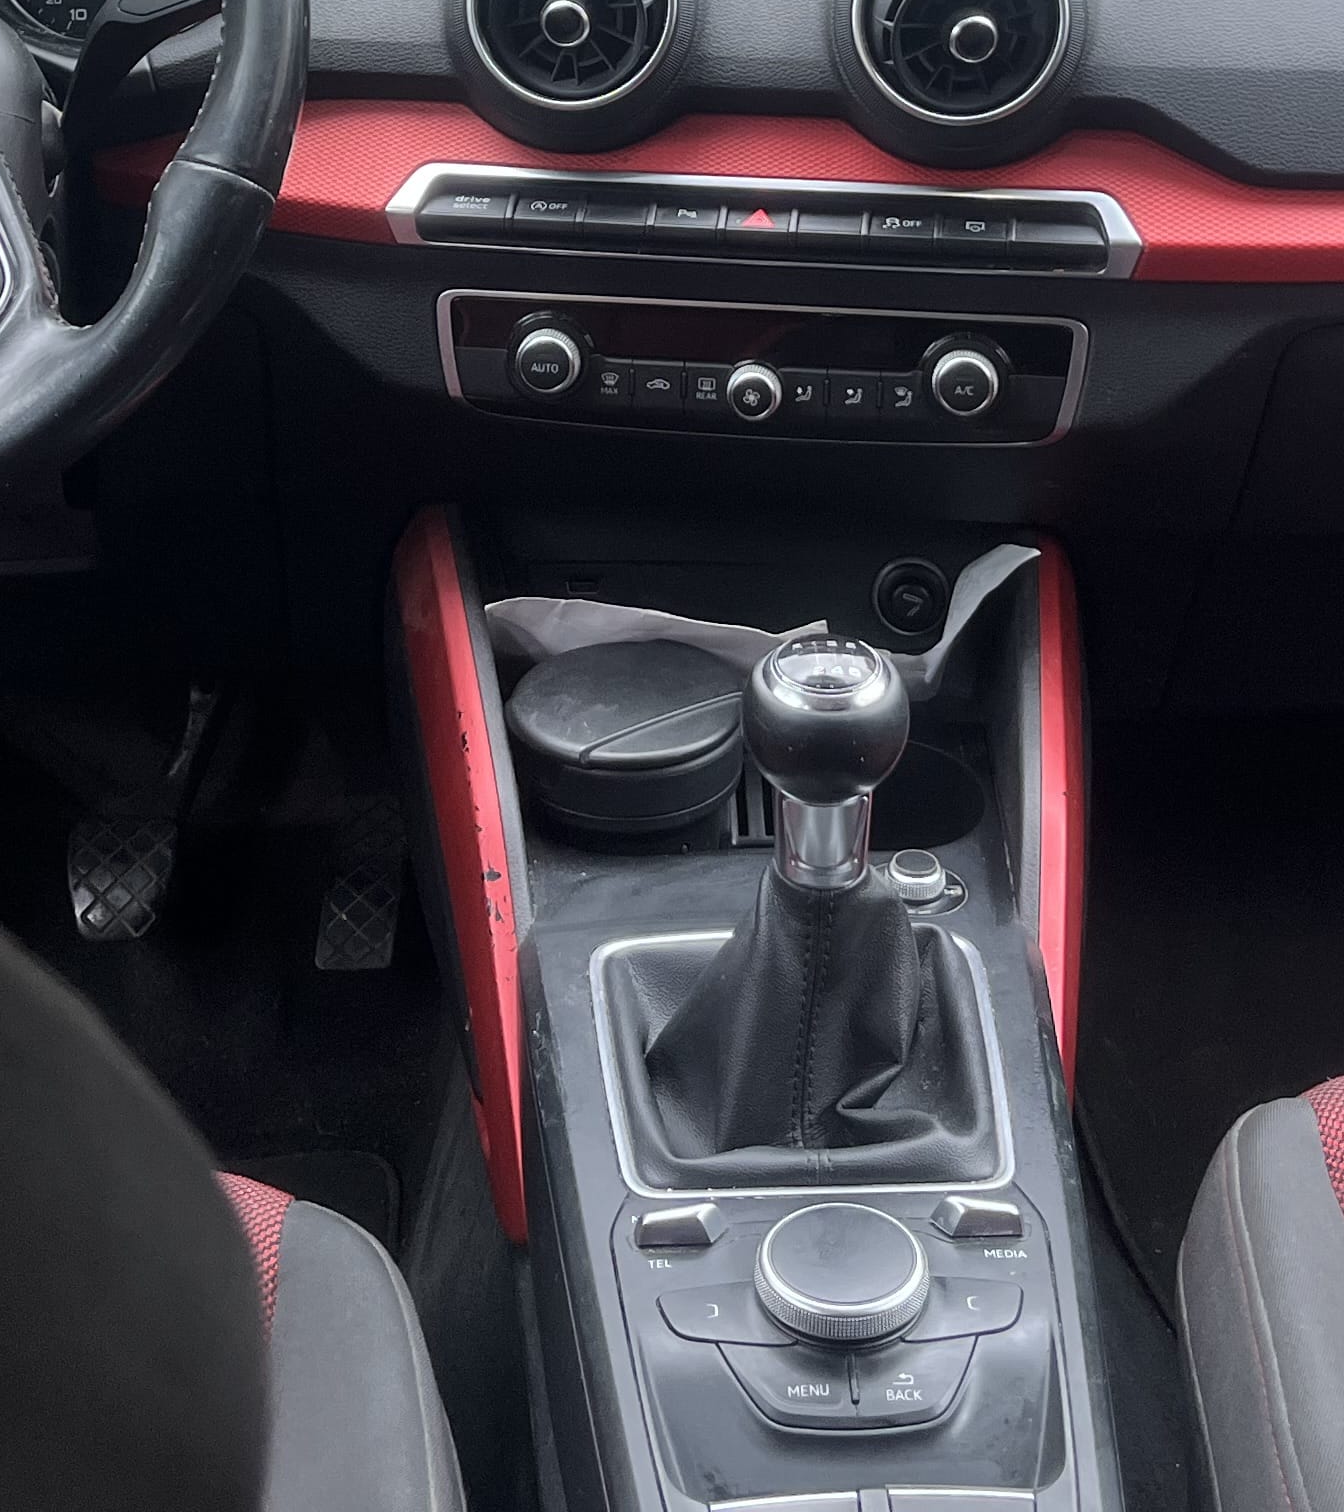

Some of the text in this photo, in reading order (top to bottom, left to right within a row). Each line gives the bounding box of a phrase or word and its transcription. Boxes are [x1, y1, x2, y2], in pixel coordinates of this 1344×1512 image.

[69, 8, 88, 22] 10
[454, 194, 492, 203] drive
[452, 202, 489, 210] select
[548, 202, 568, 210] OFF
[902, 219, 922, 228] OFF
[530, 363, 559, 375] AUTO
[600, 387, 619, 395] MAX
[695, 391, 718, 400] REAR
[954, 385, 974, 397] A/C
[983, 1248, 1028, 1261] MEDIA
[647, 1259, 673, 1269] TEL
[786, 1383, 831, 1399] MENU
[885, 1388, 923, 1402] BACK
